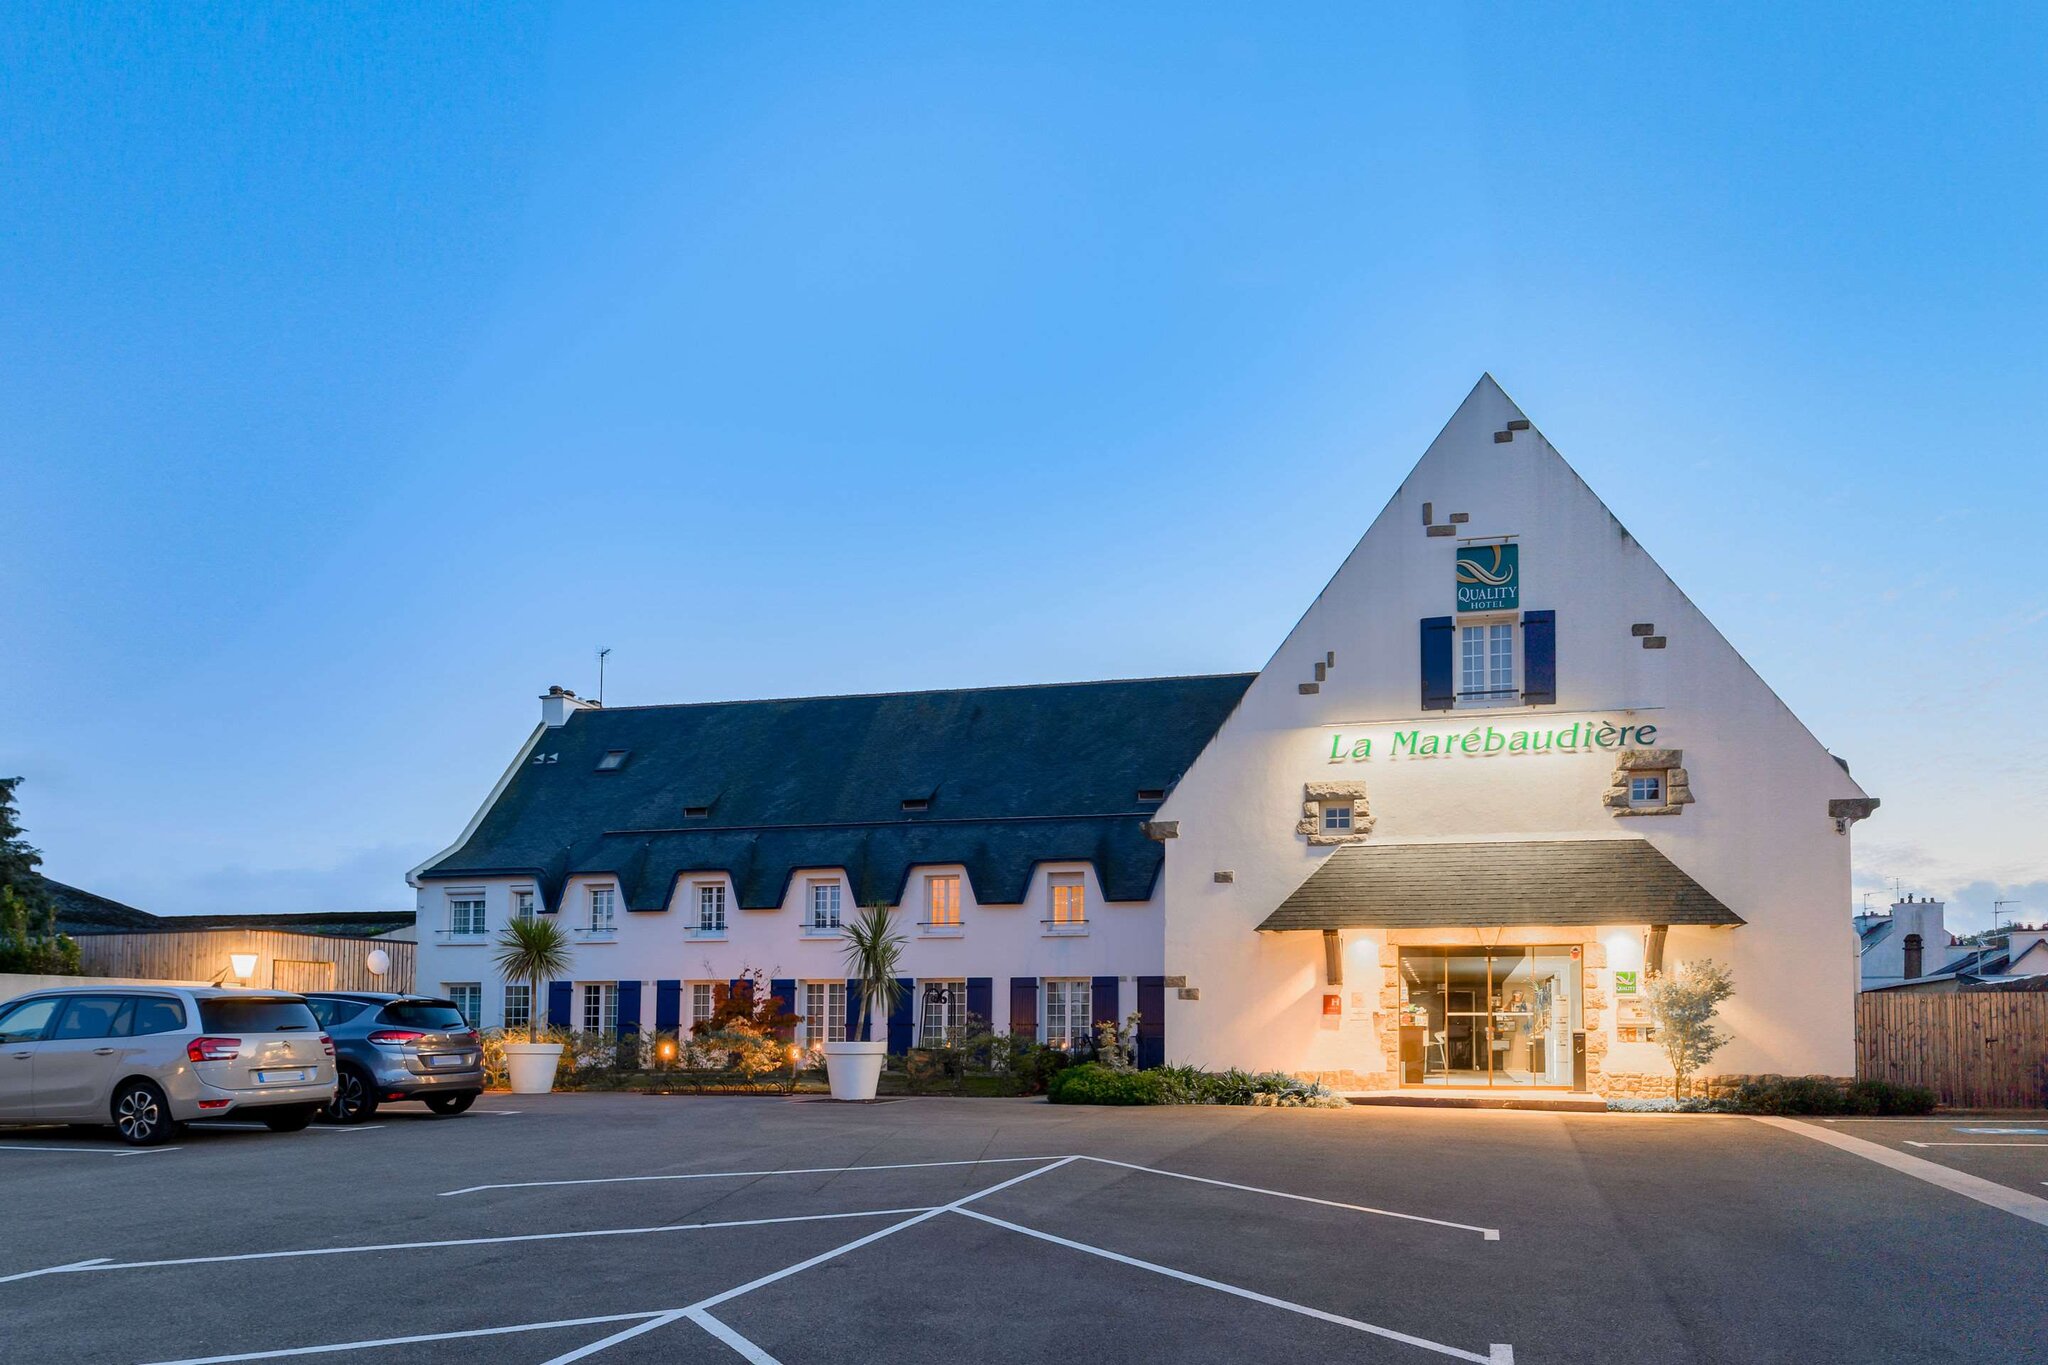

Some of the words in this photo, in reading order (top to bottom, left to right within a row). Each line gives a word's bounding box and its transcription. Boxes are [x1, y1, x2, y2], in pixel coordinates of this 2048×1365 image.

[1458, 586, 1517, 602] QUALITY
[1471, 601, 1505, 609] HOTEL
[1328, 734, 1372, 759] La
[1389, 720, 1657, 756] Marébaudière
